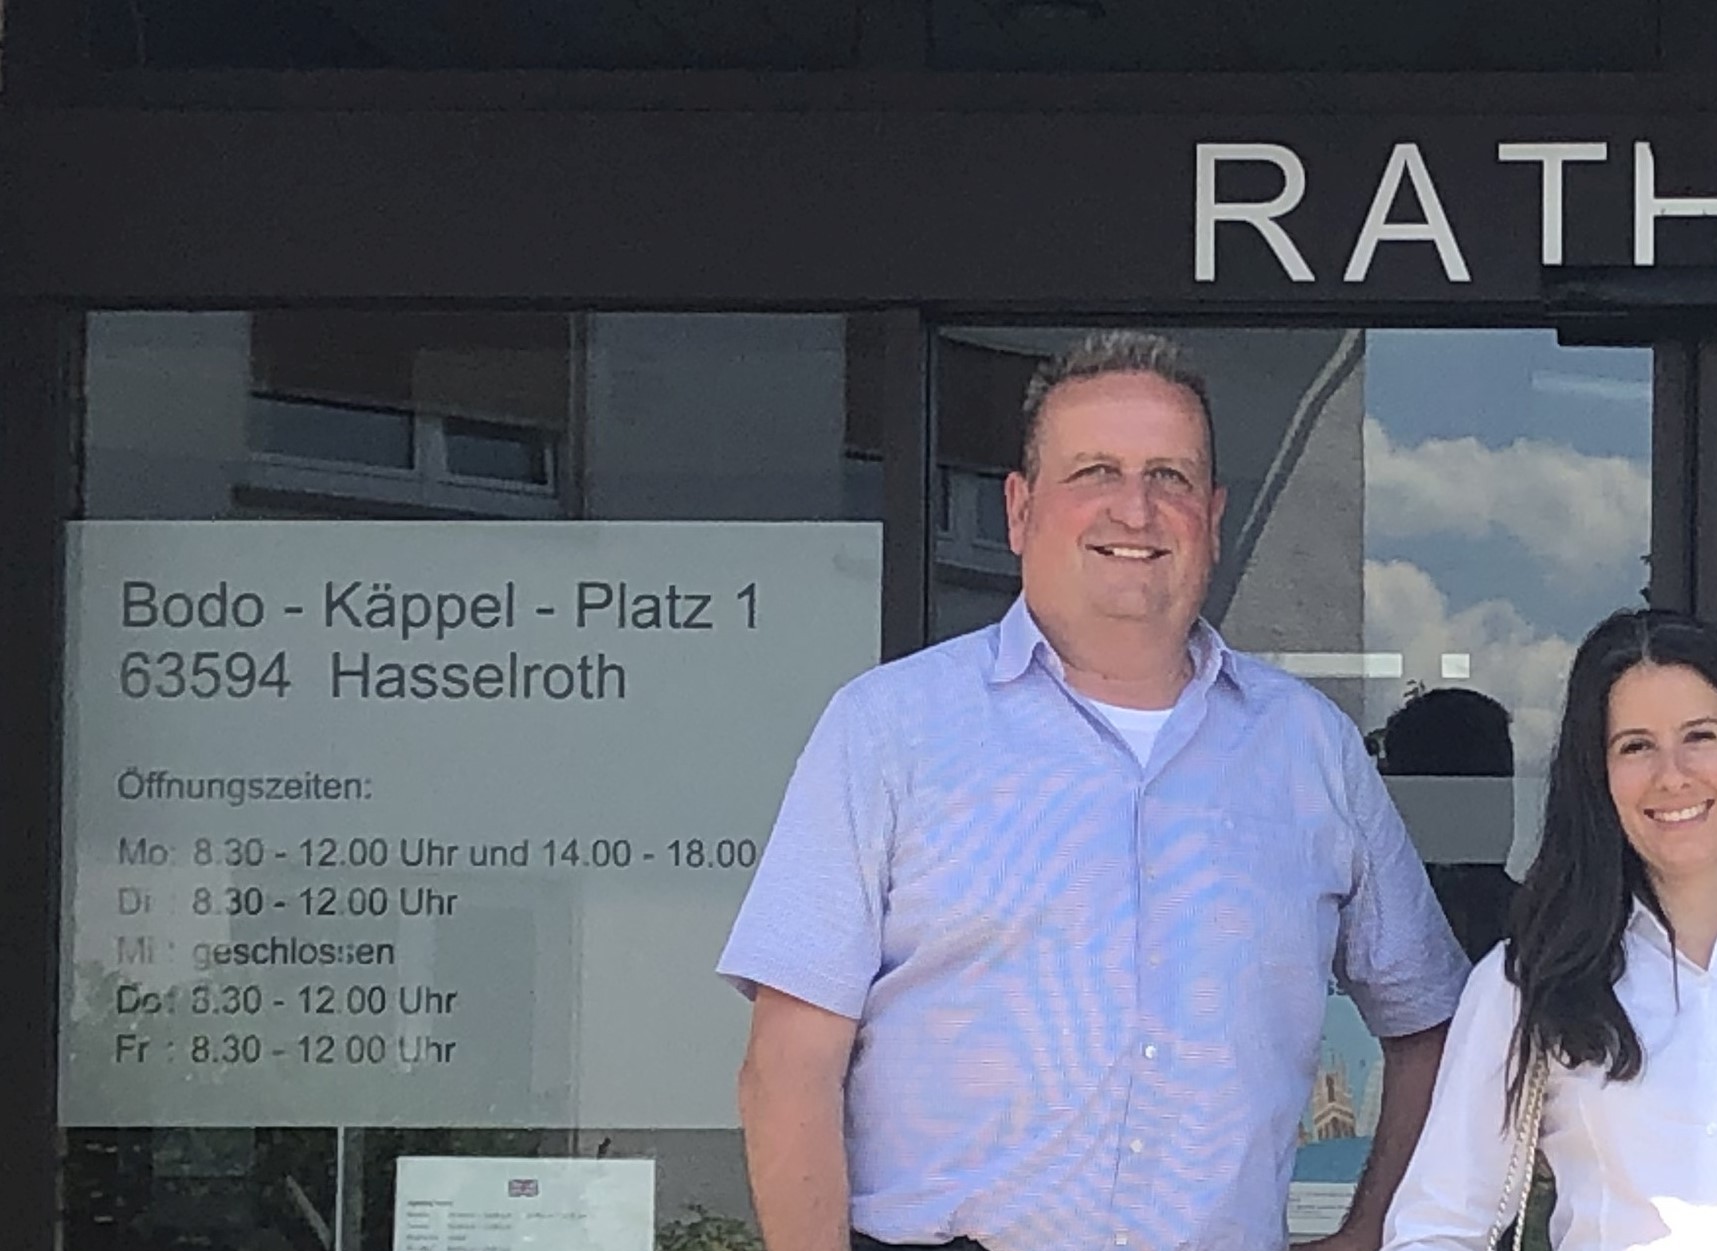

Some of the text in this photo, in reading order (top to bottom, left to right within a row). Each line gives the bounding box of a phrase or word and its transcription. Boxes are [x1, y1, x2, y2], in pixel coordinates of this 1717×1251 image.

[121, 580, 758, 641] Bodo - Käppel - Platz 1
[120, 650, 626, 700] 63594 Hasselroth
[116, 767, 373, 807] Öffnungszeiten:
[193, 837, 265, 867] 8.30
[300, 837, 388, 868] 12.00
[400, 837, 460, 868] Uhr
[469, 839, 530, 868] und
[542, 838, 632, 868] 14.00
[667, 838, 758, 869] 18.00
[299, 886, 388, 917] 12.00
[400, 887, 459, 916] Uhr
[192, 936, 396, 970] geschlossen
[399, 985, 459, 1015] Uhr
[191, 1034, 262, 1064] 8.30
[398, 1034, 457, 1064] Uhr
